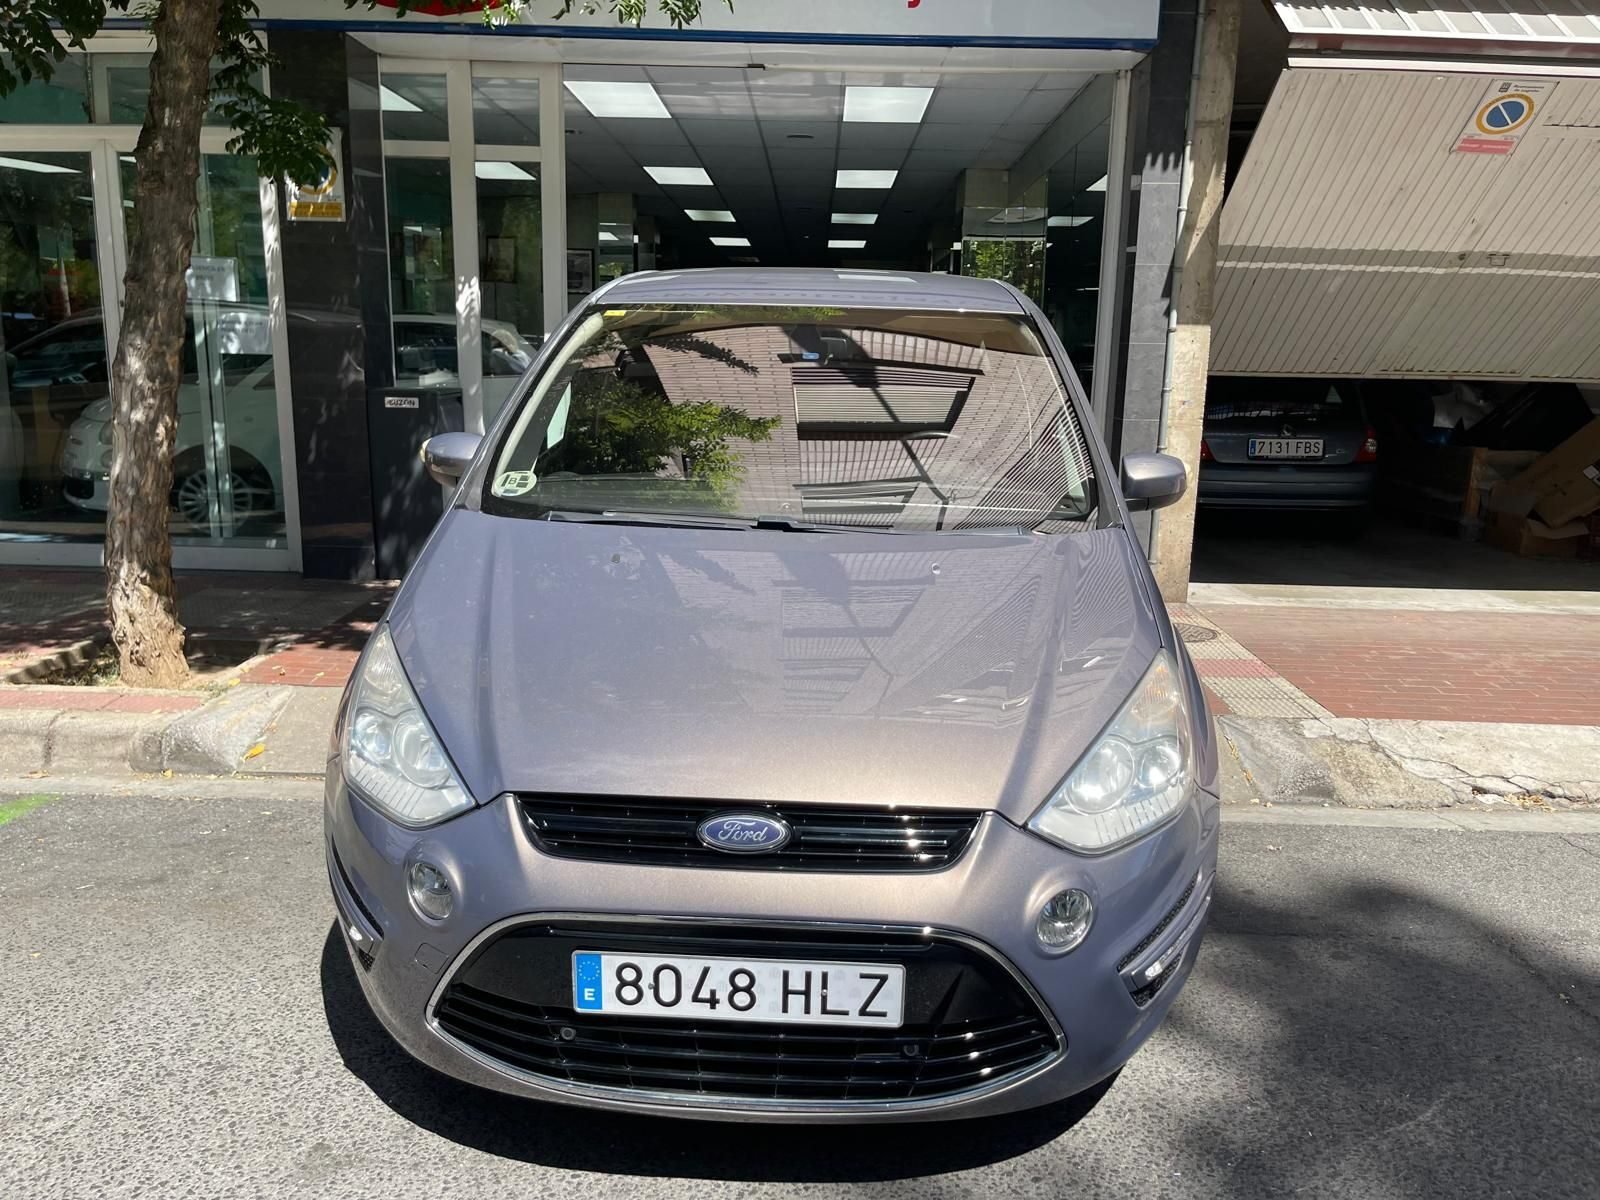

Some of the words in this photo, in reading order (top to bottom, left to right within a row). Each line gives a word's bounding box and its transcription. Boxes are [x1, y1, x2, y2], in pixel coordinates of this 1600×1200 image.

[1257, 441, 1290, 454] 7131
[1295, 441, 1321, 454] FBS
[718, 820, 769, 841] Ford
[583, 987, 596, 1001] E
[614, 961, 757, 1012] 8048
[781, 969, 890, 1018] HLZ
